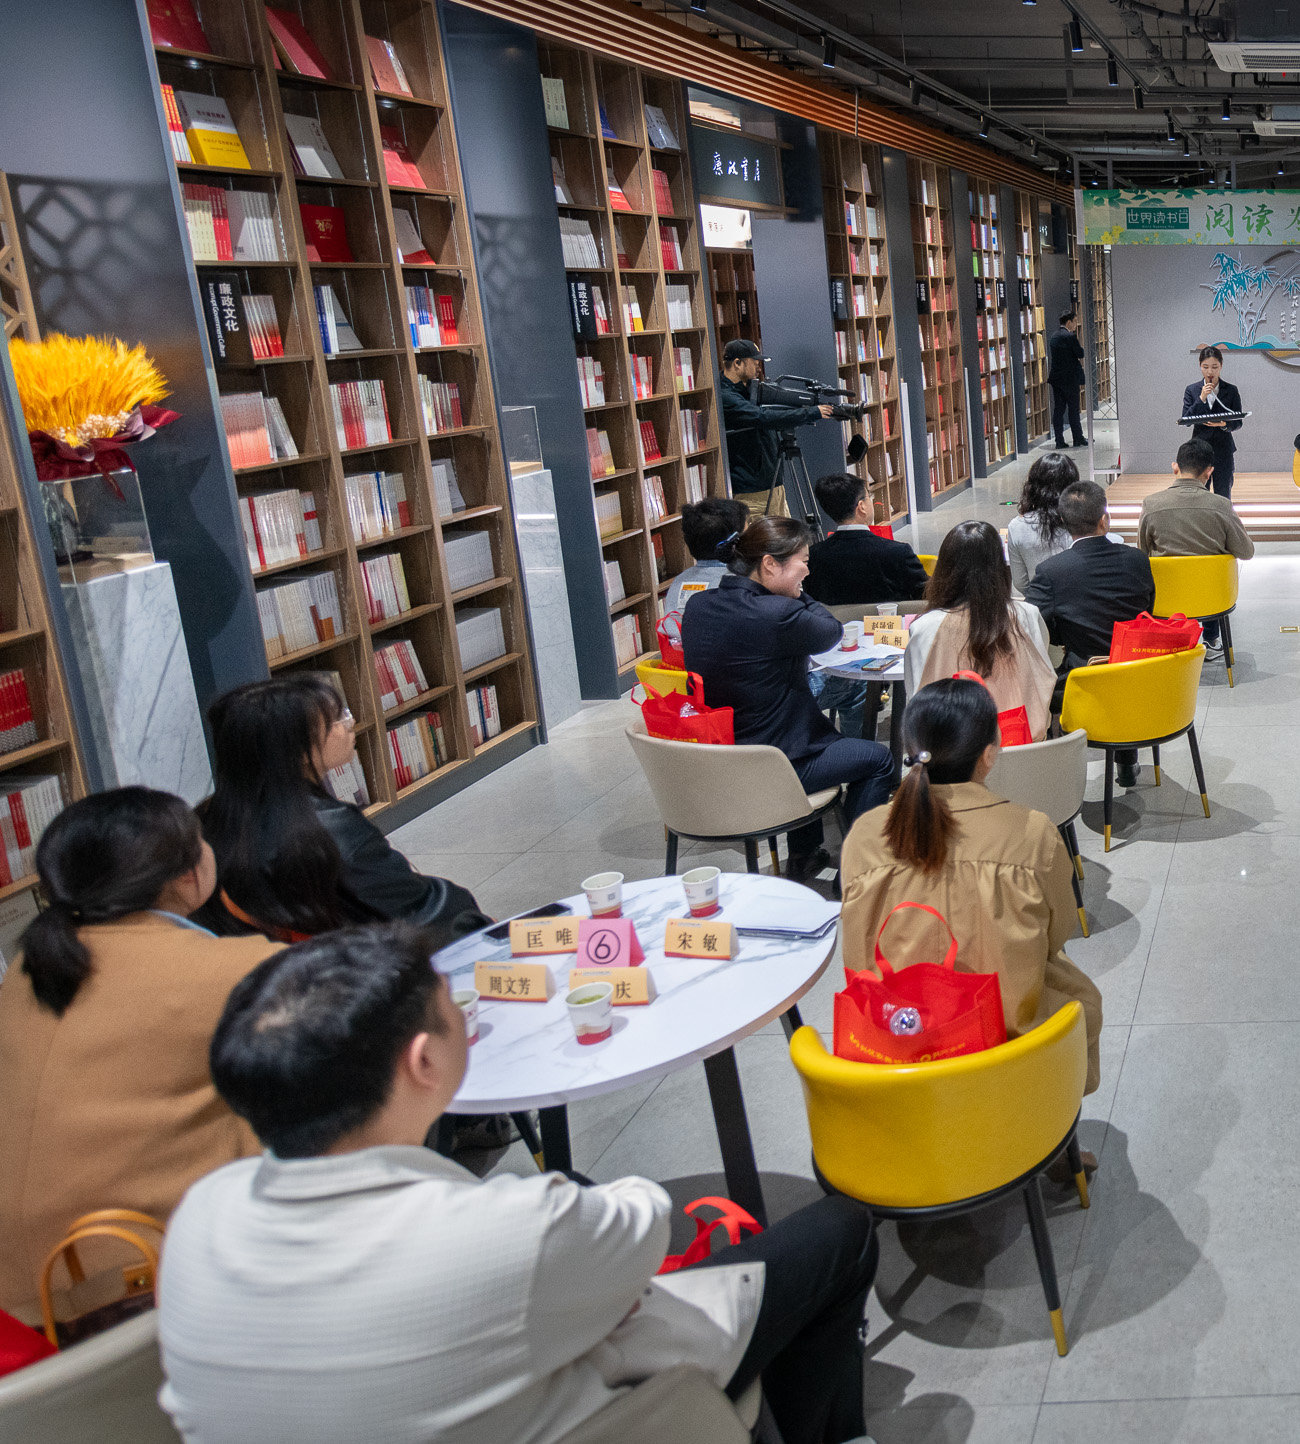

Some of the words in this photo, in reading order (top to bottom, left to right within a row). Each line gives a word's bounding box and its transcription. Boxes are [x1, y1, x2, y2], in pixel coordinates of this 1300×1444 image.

[1127, 209, 1189, 224] 世界读书日
[1205, 203, 1275, 238] 阅读
[219, 282, 240, 332] 廉政文化
[527, 928, 573, 949] 匡唯
[677, 932, 718, 952] 宋敏
[490, 976, 531, 995] 周文芳
